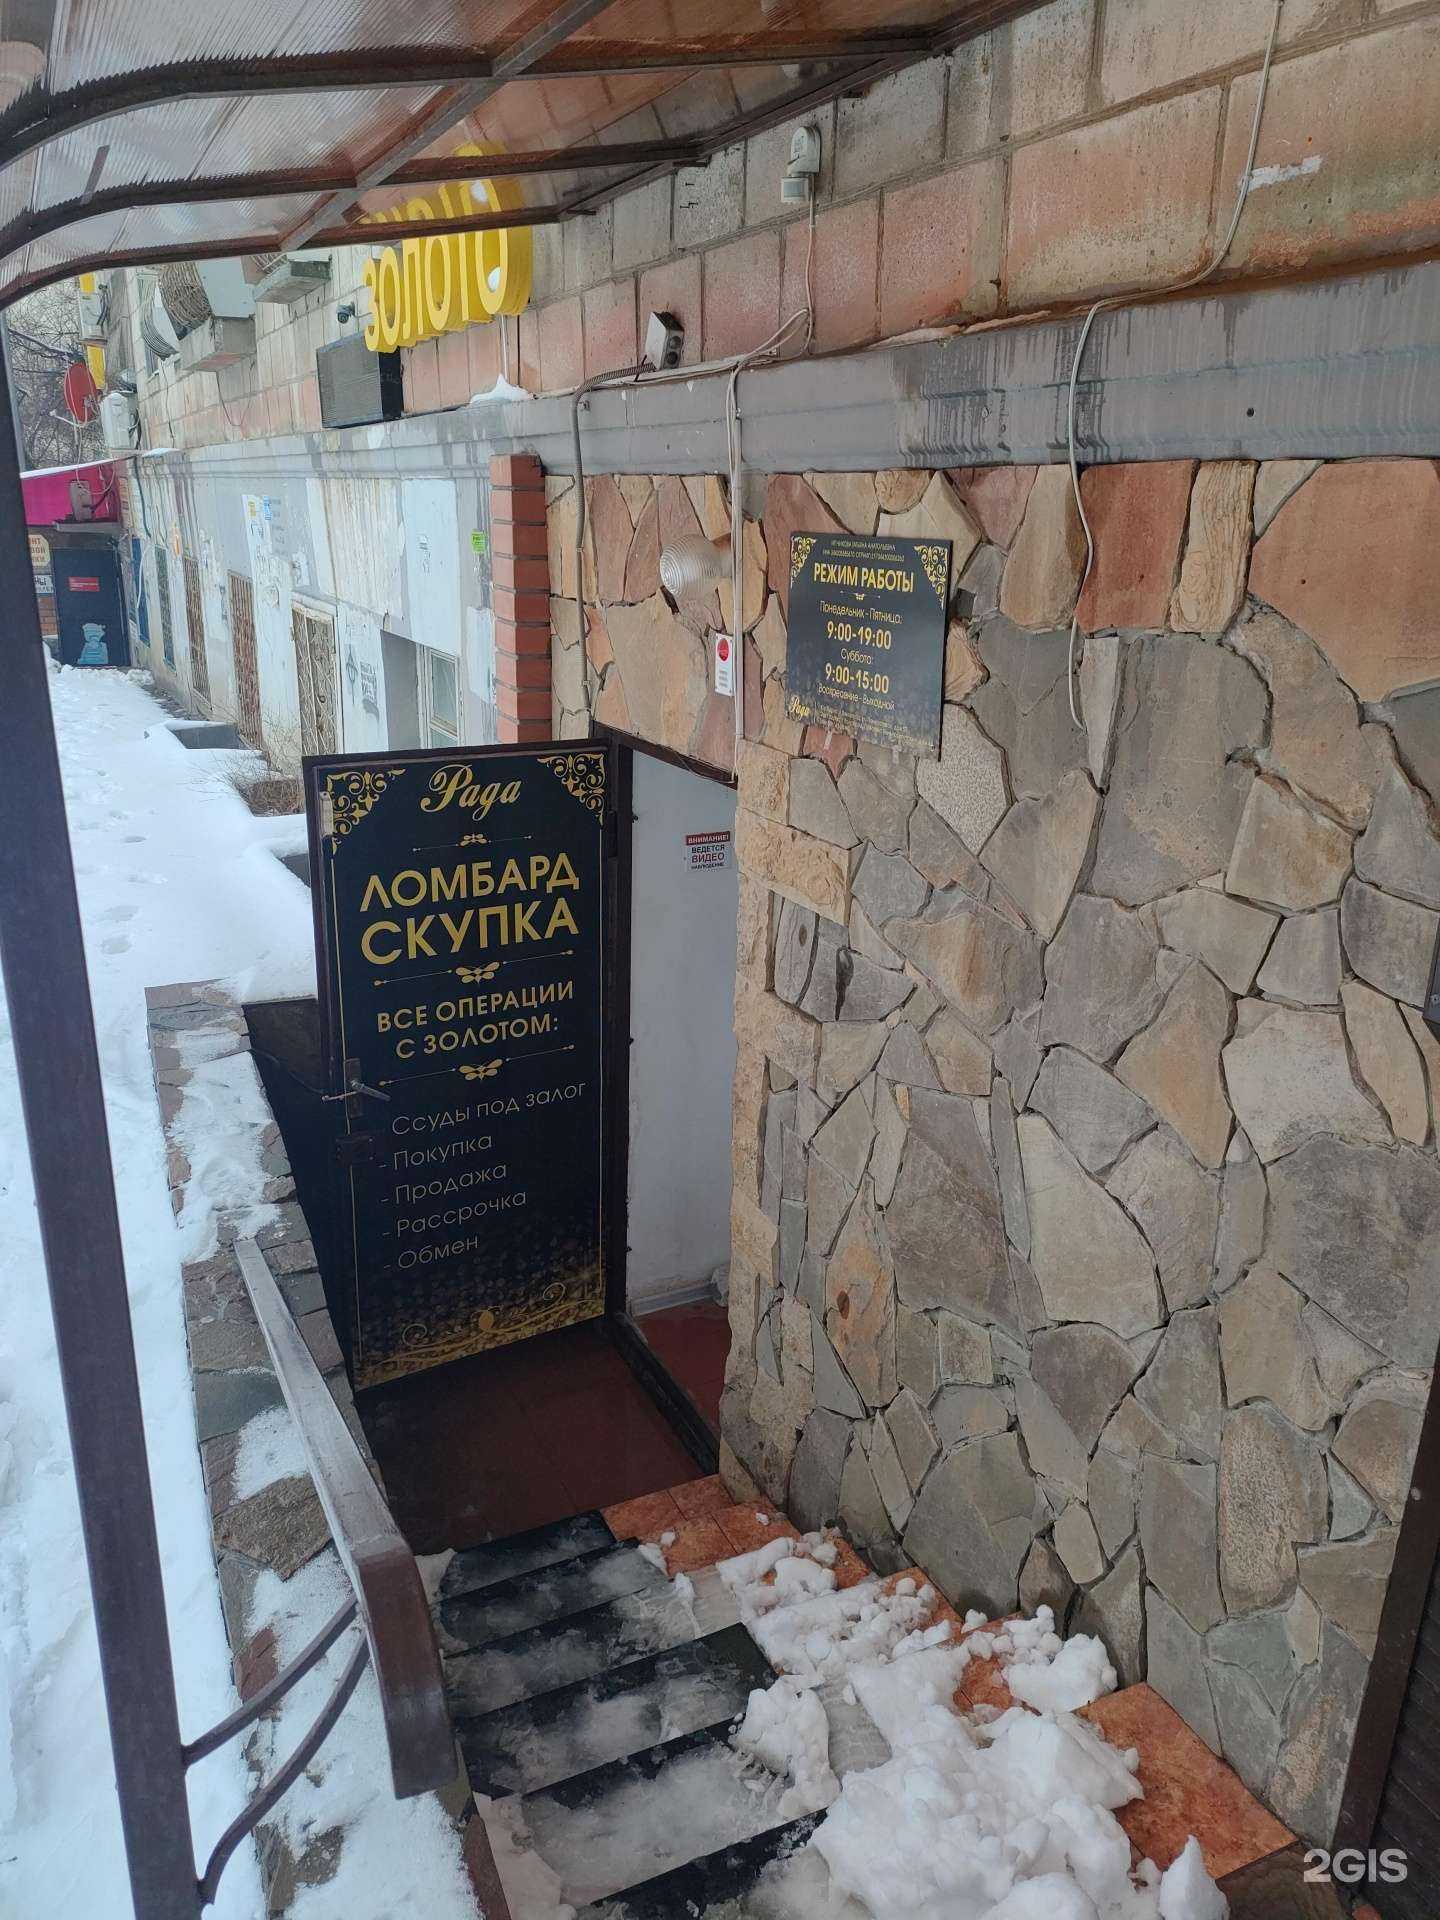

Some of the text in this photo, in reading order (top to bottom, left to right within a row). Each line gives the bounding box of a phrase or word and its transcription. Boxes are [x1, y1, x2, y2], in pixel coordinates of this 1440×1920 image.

[814, 563, 914, 592] РЕЖИМ РАБОТЫ
[820, 600, 865, 617] Понедельник
[827, 621, 892, 650] 9:00-19:00
[825, 662, 889, 694] 9:00-15:00
[419, 764, 522, 822] Рада
[687, 834, 729, 844] ВНИМАНИЕ!
[691, 844, 725, 854] ВЕДЕТСЯ
[691, 852, 725, 863] ВИДЕО
[359, 852, 580, 913] ЛОМБАРД
[360, 897, 580, 966] СКУПКА
[376, 980, 574, 1033] ВСЕ ОПЕРАЦИИ
[395, 1012, 559, 1060] С ЗОЛОТОМ:
[391, 1081, 587, 1135] Ссуды под залог
[393, 1134, 493, 1171] Покупка
[395, 1164, 508, 1205] Продажа
[397, 1191, 527, 1238] Рассрочка
[397, 1236, 479, 1270] Обмен
